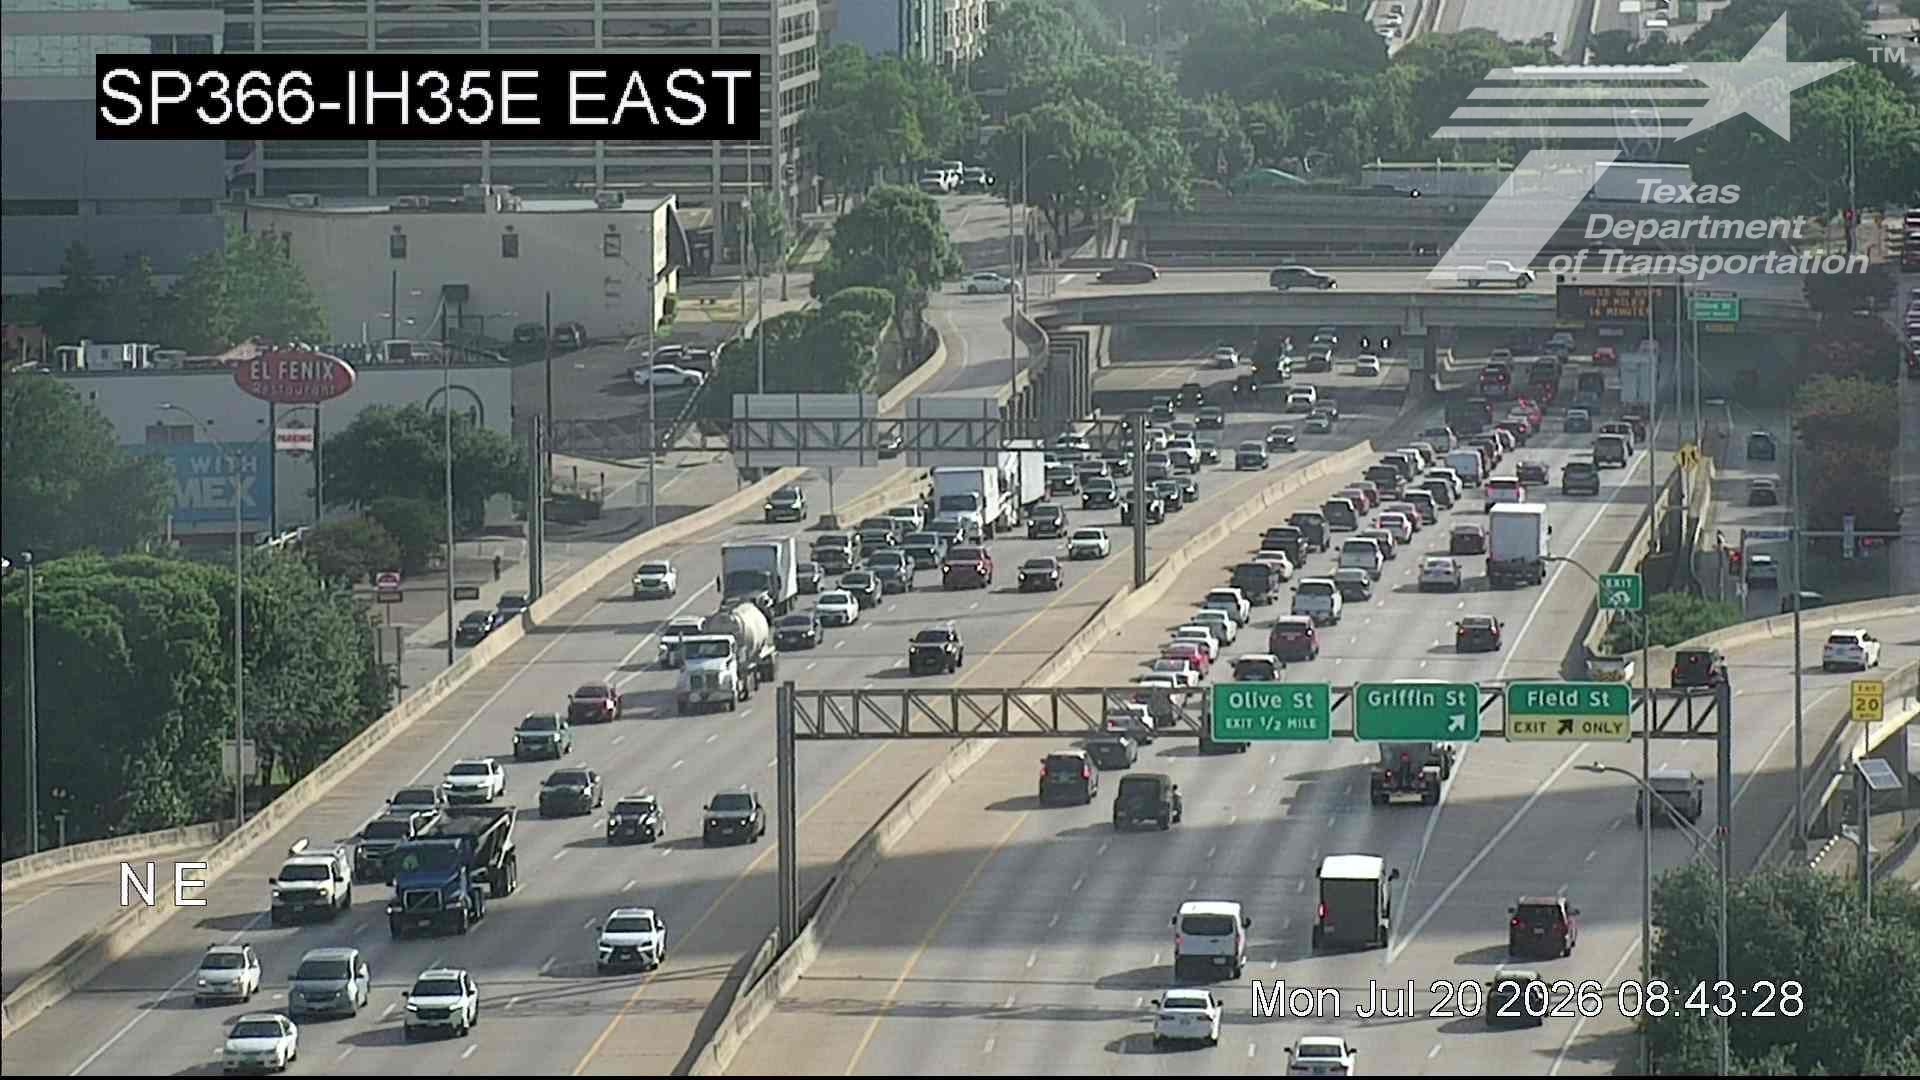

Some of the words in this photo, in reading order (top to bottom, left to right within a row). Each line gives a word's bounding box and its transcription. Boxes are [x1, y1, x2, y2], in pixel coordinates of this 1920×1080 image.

[250, 361, 271, 380] EL
[279, 361, 334, 380] FENIX
[191, 455, 257, 474] WITH
[1229, 691, 1283, 709] Olive
[1293, 692, 1314, 709] St
[1367, 689, 1435, 708] Griffin
[1446, 690, 1467, 707] St
[1527, 689, 1578, 708] Field
[1589, 690, 1610, 707] St
[1855, 697, 1880, 712] 20
[1225, 717, 1254, 729] EXIT
[1287, 717, 1317, 729] MILE
[1513, 721, 1547, 734] EXIT
[1582, 721, 1623, 734] ONLY
